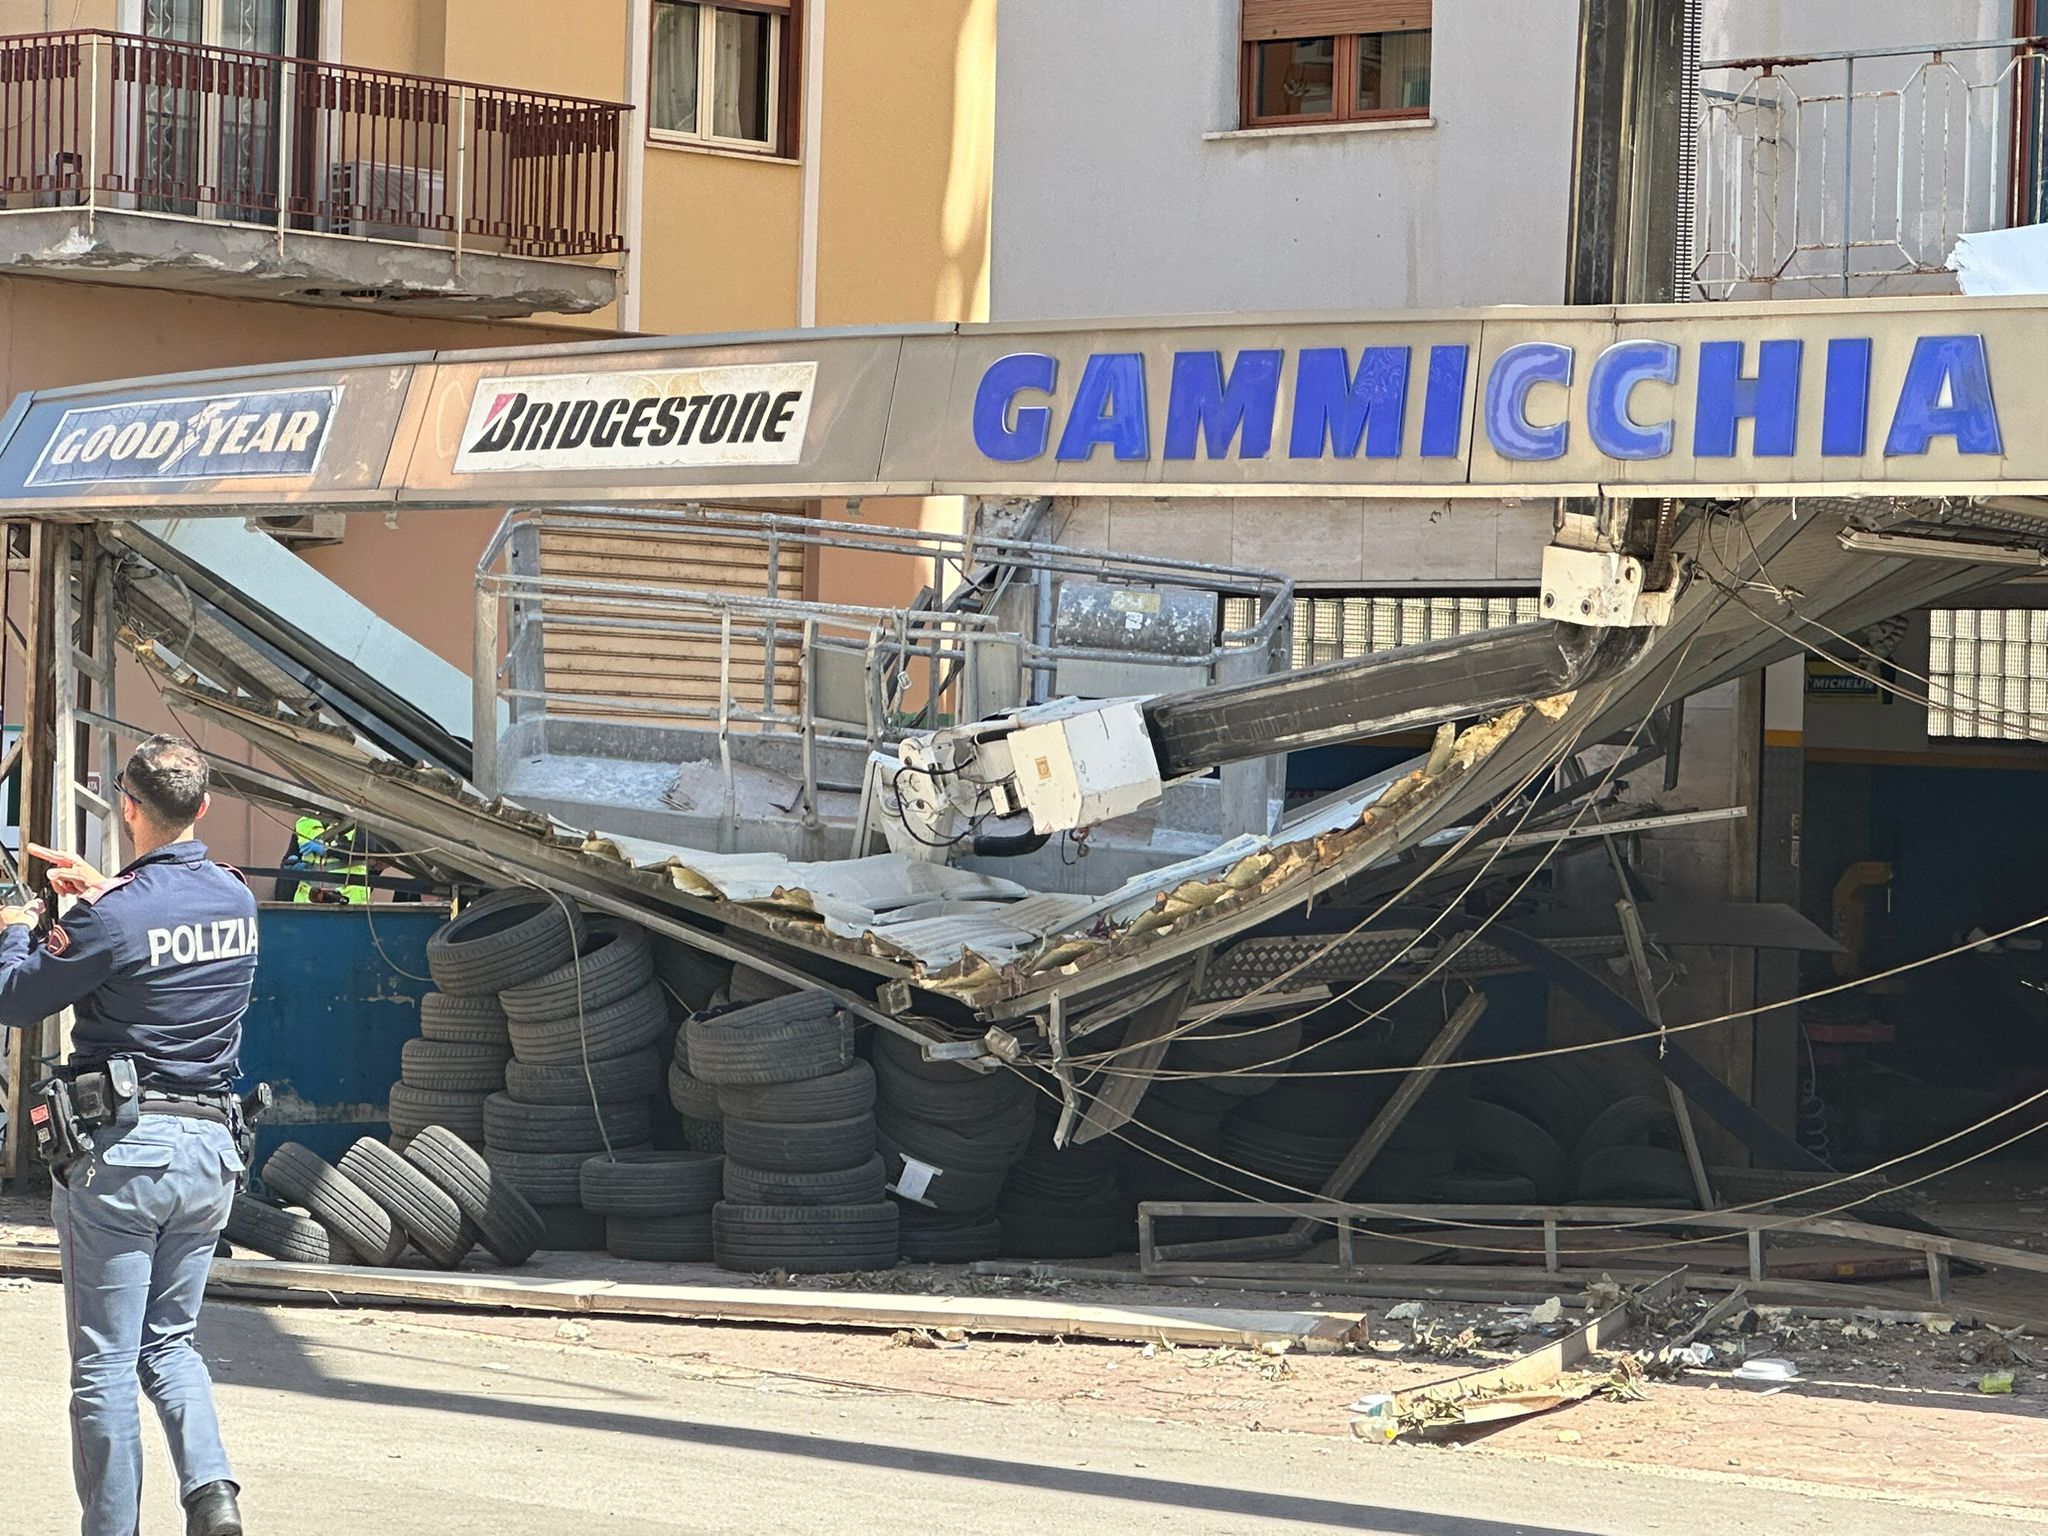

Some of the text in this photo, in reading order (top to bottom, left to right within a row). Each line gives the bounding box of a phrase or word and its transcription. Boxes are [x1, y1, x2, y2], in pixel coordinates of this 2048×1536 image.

[468, 390, 802, 453] BRIDGESTONE
[972, 333, 2003, 463] GAMMICCHIA
[148, 917, 258, 966] POLIZIA
